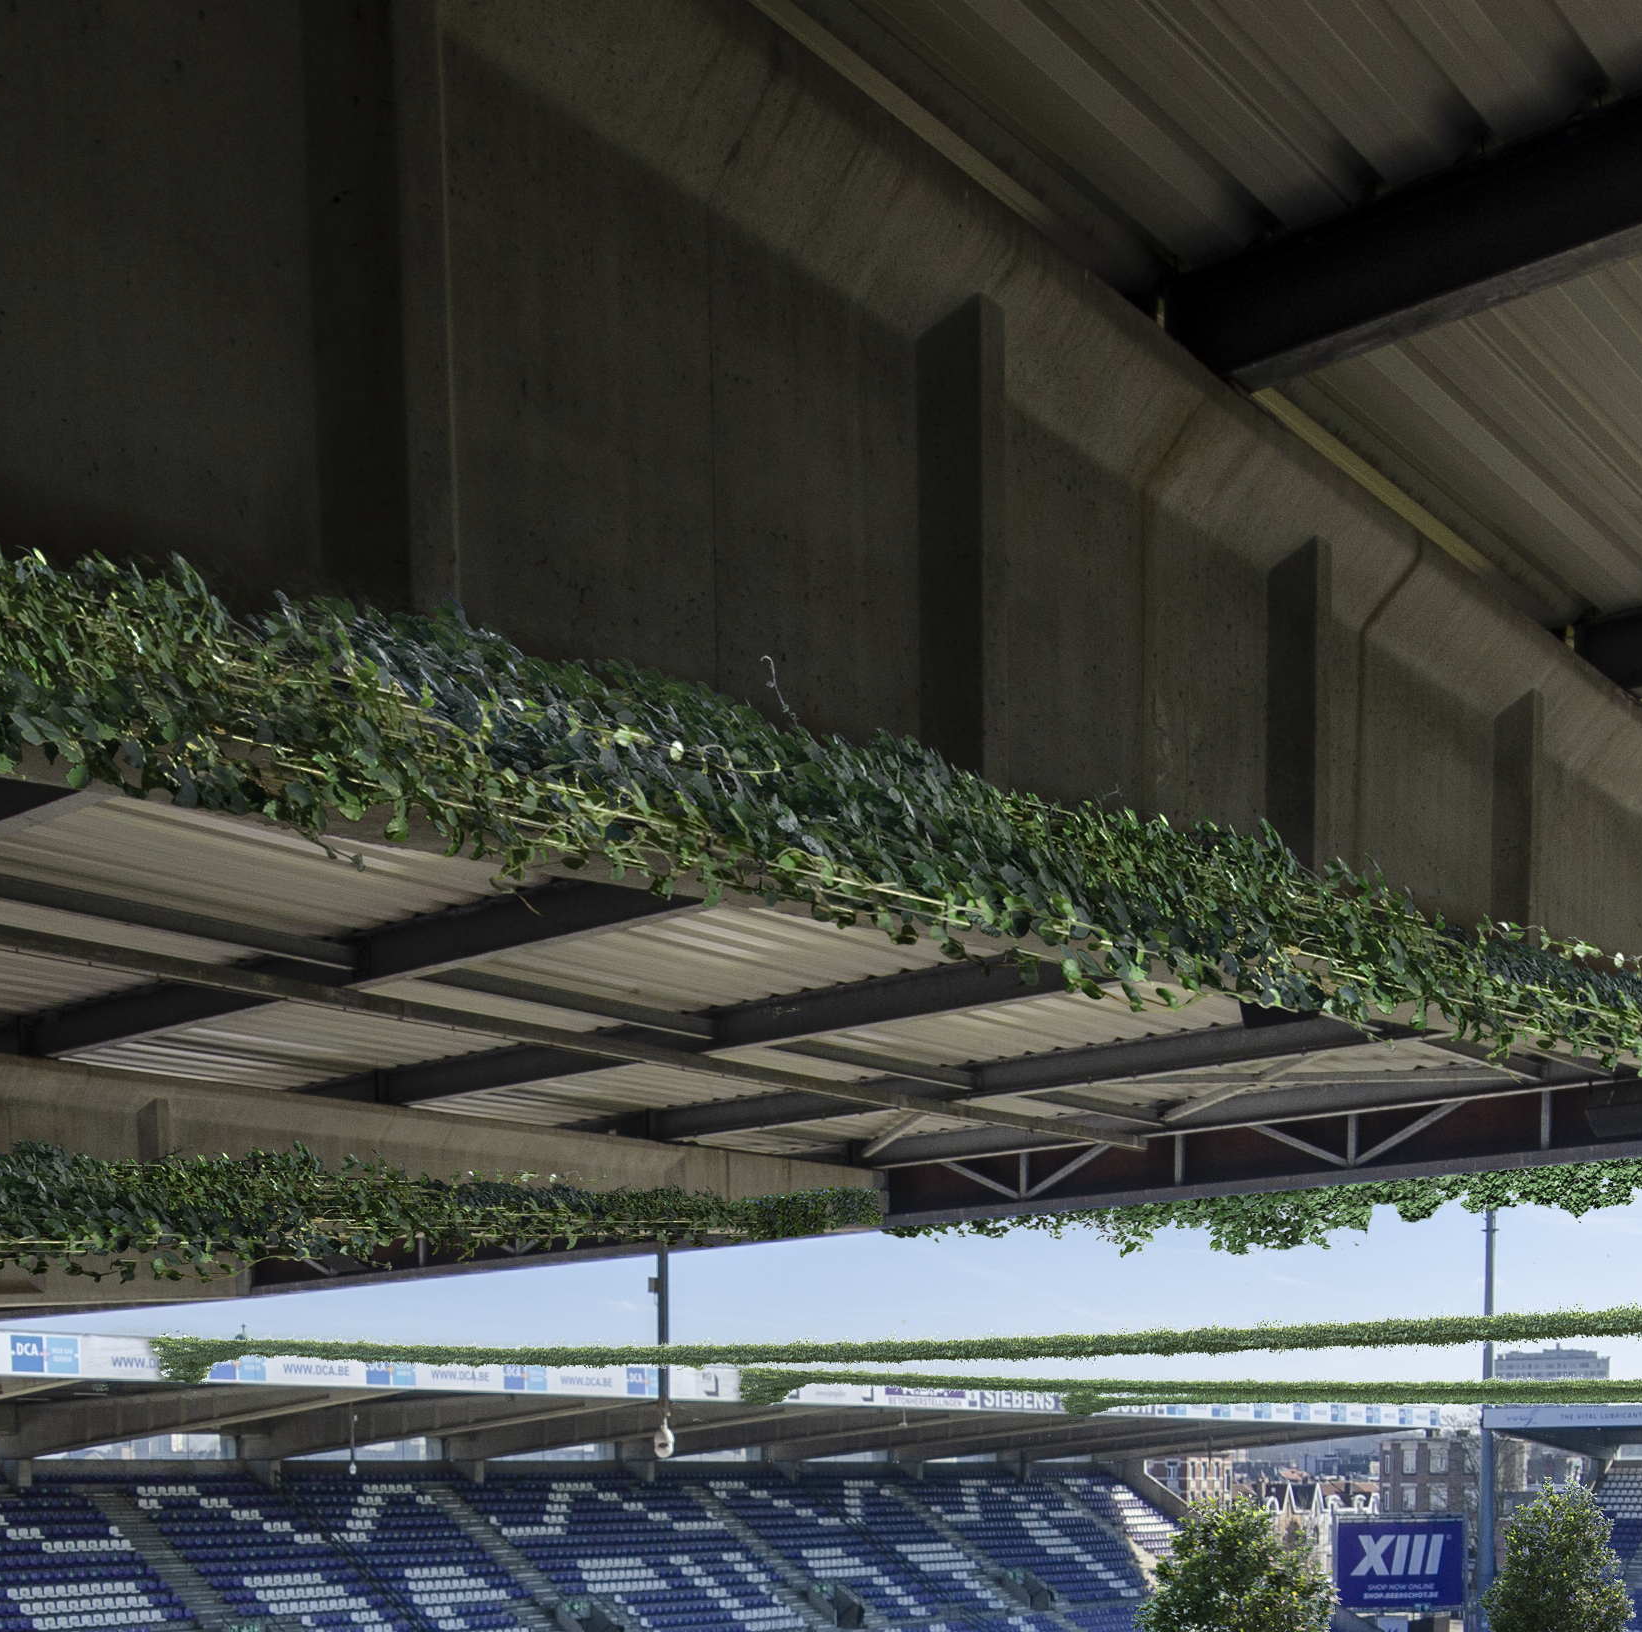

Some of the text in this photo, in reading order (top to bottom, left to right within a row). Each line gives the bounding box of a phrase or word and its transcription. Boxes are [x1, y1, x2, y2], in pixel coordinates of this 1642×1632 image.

[111, 1355, 158, 1370] WWW.D
[283, 1363, 350, 1377] WWW.DCA.BE
[431, 1369, 490, 1383] WWW.DCA.BE
[560, 1375, 613, 1388] WWW.DCA.BE
[983, 1390, 1055, 1411] SIEBENS
[1560, 1411, 1642, 1421] THE VITAL LUBRICANT
[1350, 1533, 1445, 1576] XIII
[1367, 1582, 1435, 1591] SHOP NOW ONLINE
